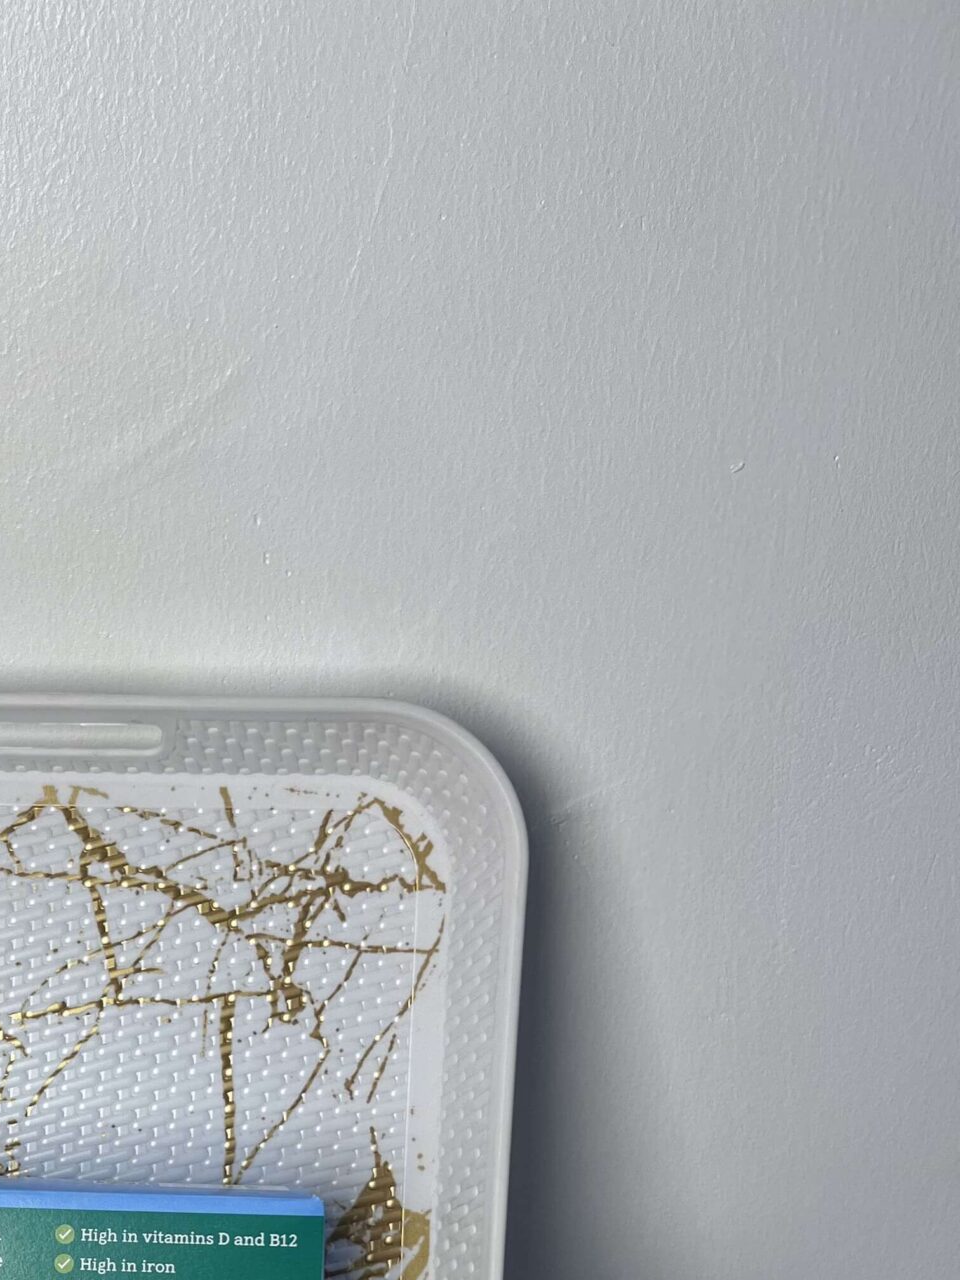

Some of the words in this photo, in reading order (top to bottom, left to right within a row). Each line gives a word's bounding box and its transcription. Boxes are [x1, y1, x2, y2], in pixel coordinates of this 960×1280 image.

[81, 1228, 118, 1243] High
[123, 1229, 138, 1243] in
[143, 1231, 214, 1246] vitamins
[218, 1233, 230, 1246] D
[234, 1233, 265, 1247] and
[270, 1234, 298, 1248] B12
[80, 1258, 117, 1274] High
[121, 1259, 137, 1272] in
[142, 1260, 176, 1274] iron
